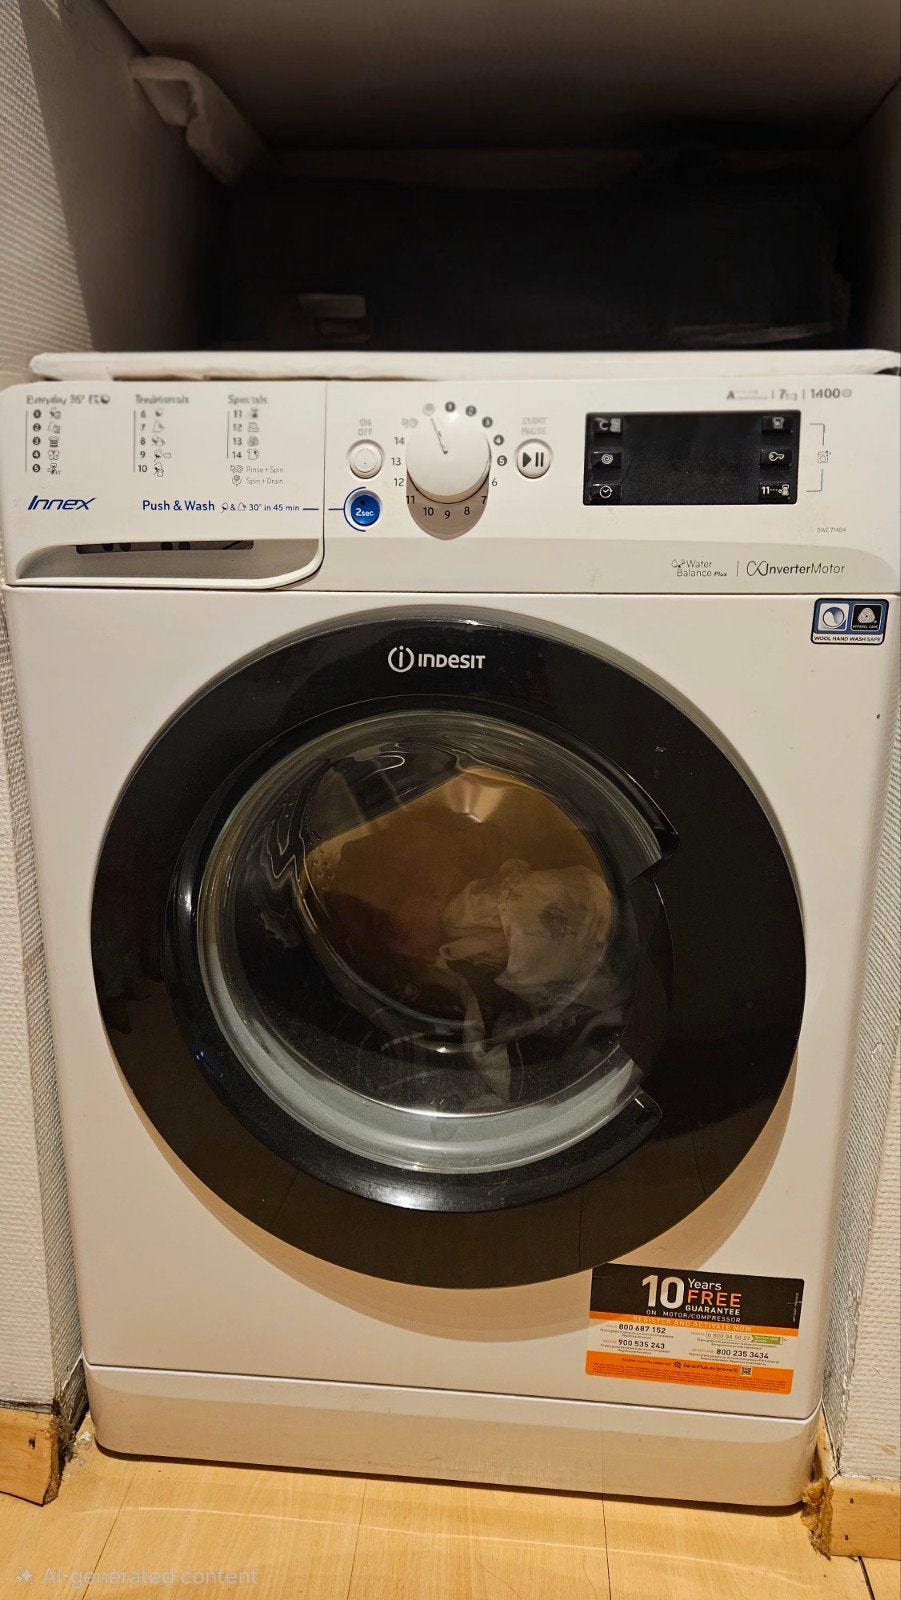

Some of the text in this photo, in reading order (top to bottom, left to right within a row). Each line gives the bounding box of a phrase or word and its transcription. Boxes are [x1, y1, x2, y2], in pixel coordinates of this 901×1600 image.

[811, 388, 840, 399] 1400
[233, 410, 242, 418] 11
[140, 437, 146, 445] 8
[233, 437, 243, 446] 13
[394, 436, 405, 445] 14
[140, 451, 146, 459] 9
[232, 451, 242, 460] 14
[391, 458, 402, 466] 13
[138, 465, 148, 473] 10
[269, 466, 284, 475] Spin
[394, 478, 405, 487] 12
[491, 478, 498, 487] 6
[762, 486, 770, 494] 11
[27, 495, 96, 510] Innex
[406, 496, 415, 504] 11
[481, 496, 487, 504] 7
[142, 500, 215, 511] Push & Wash
[273, 503, 284, 511] 45
[423, 508, 434, 516] 10
[444, 511, 451, 520] 9
[464, 507, 471, 515] 8
[686, 560, 713, 569] Water
[676, 569, 713, 577] Balance
[688, 1278, 722, 1291] Years
[642, 1274, 685, 1310] 10
[687, 1289, 742, 1308] FREE
[685, 1304, 741, 1316] GUARANTEE
[662, 1310, 741, 1323] MOTOR/COMPRESSOR
[633, 1316, 672, 1326] REGISTER
[673, 1319, 691, 1328] AND
[618, 1323, 634, 1331] 800
[635, 1324, 650, 1332] 687
[652, 1326, 666, 1334] 152
[634, 1340, 649, 1348] 535
[716, 1348, 731, 1356] 800
[733, 1350, 748, 1358] 235
[749, 1351, 769, 1359] 3434
